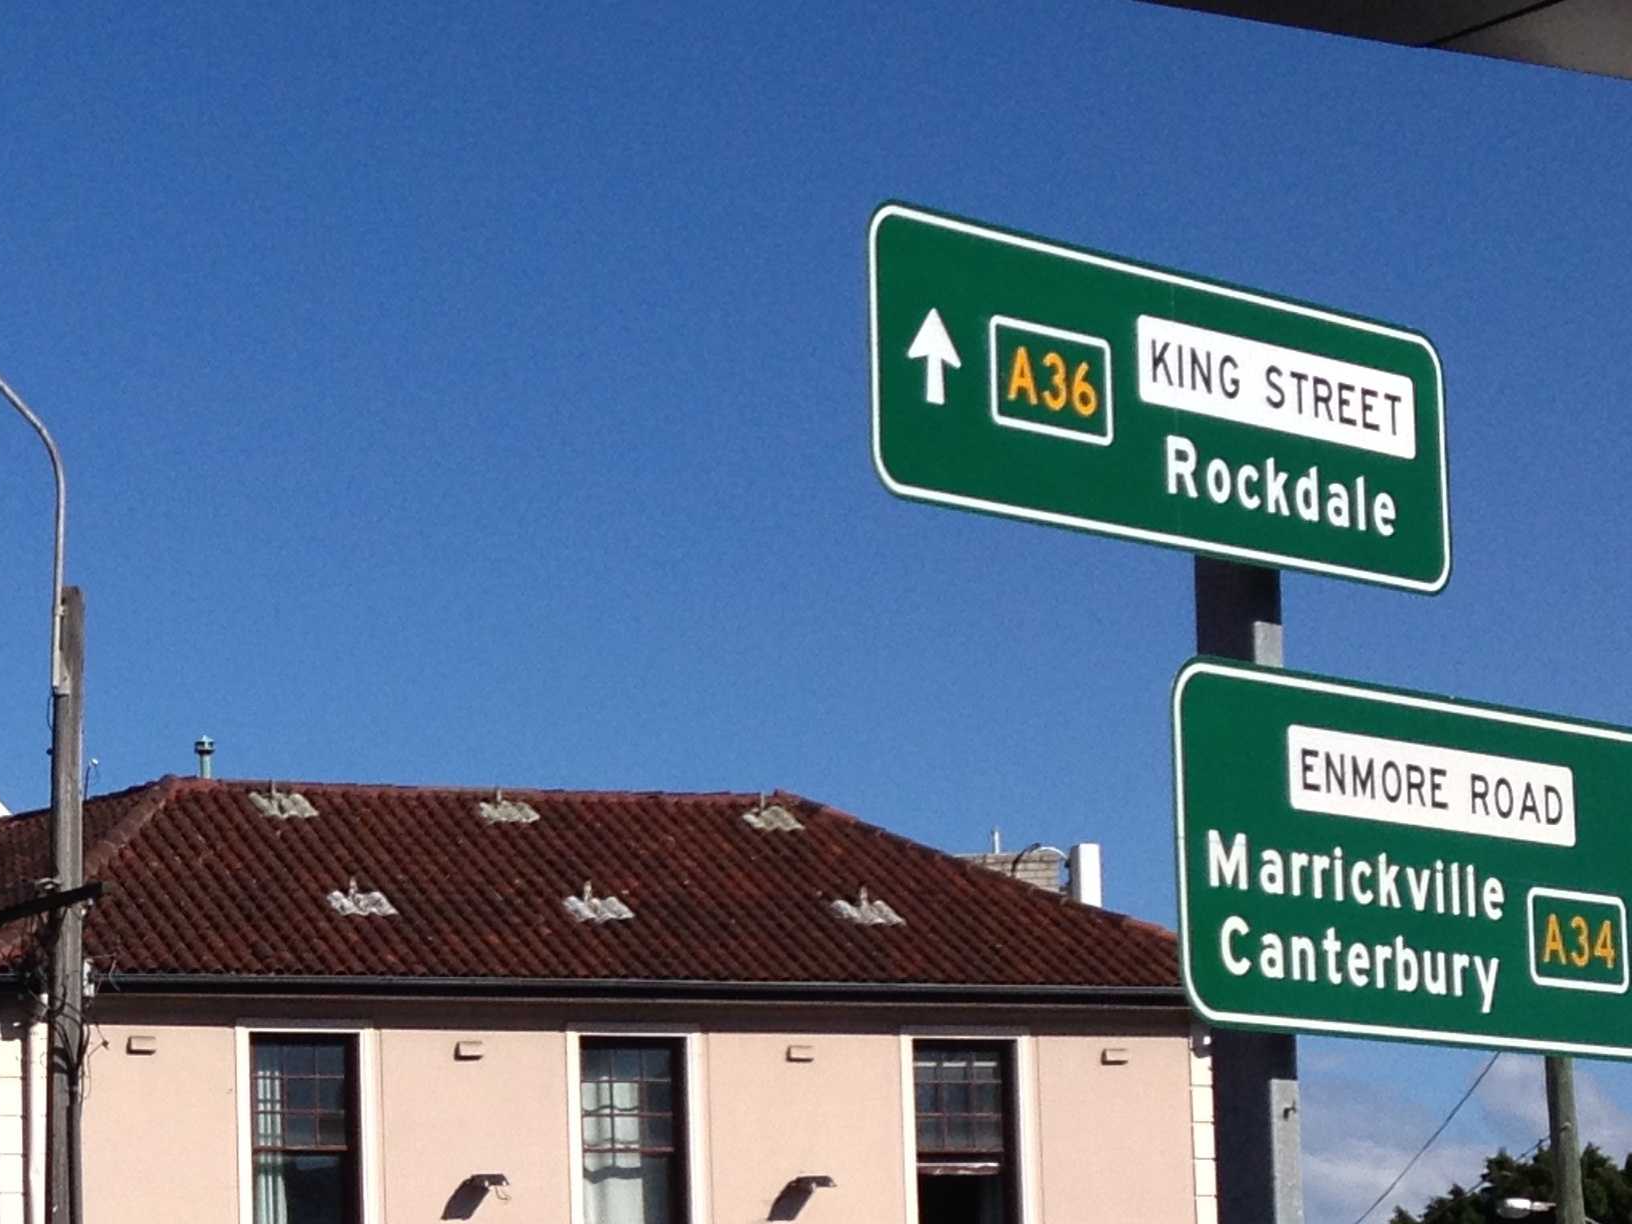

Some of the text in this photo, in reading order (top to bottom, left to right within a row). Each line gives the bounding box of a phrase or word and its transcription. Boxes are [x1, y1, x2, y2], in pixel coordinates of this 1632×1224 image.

[1007, 345, 1098, 416] A36
[1150, 337, 1402, 436] KING STREET
[1165, 436, 1397, 537] Rockdale
[1301, 748, 1564, 826] ENMORE ROAD
[1207, 829, 1505, 920] Marrickville
[1220, 915, 1501, 1013] Canterbury
[1543, 912, 1616, 969] A34
